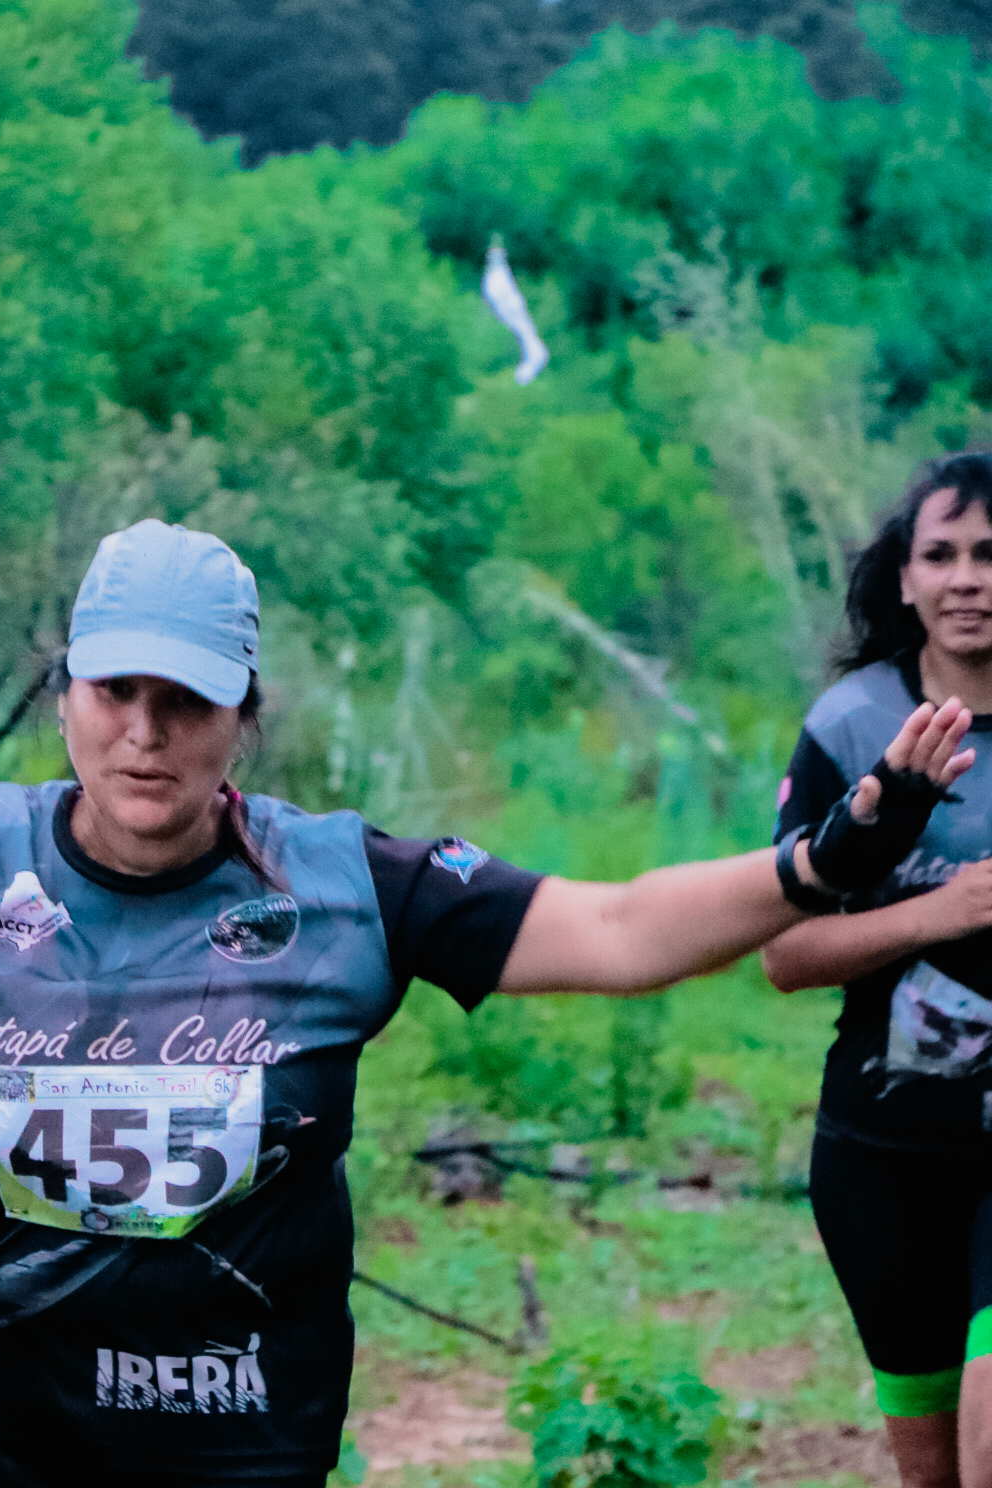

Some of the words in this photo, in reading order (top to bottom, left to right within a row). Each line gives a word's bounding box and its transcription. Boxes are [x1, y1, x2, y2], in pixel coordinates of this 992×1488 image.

[87, 1018, 137, 1061] de
[160, 1014, 302, 1065] Collar
[40, 1079, 70, 1094] San
[80, 1077, 149, 1095] Antonio
[157, 1077, 197, 1093] Trail
[9, 1107, 228, 1208] 455
